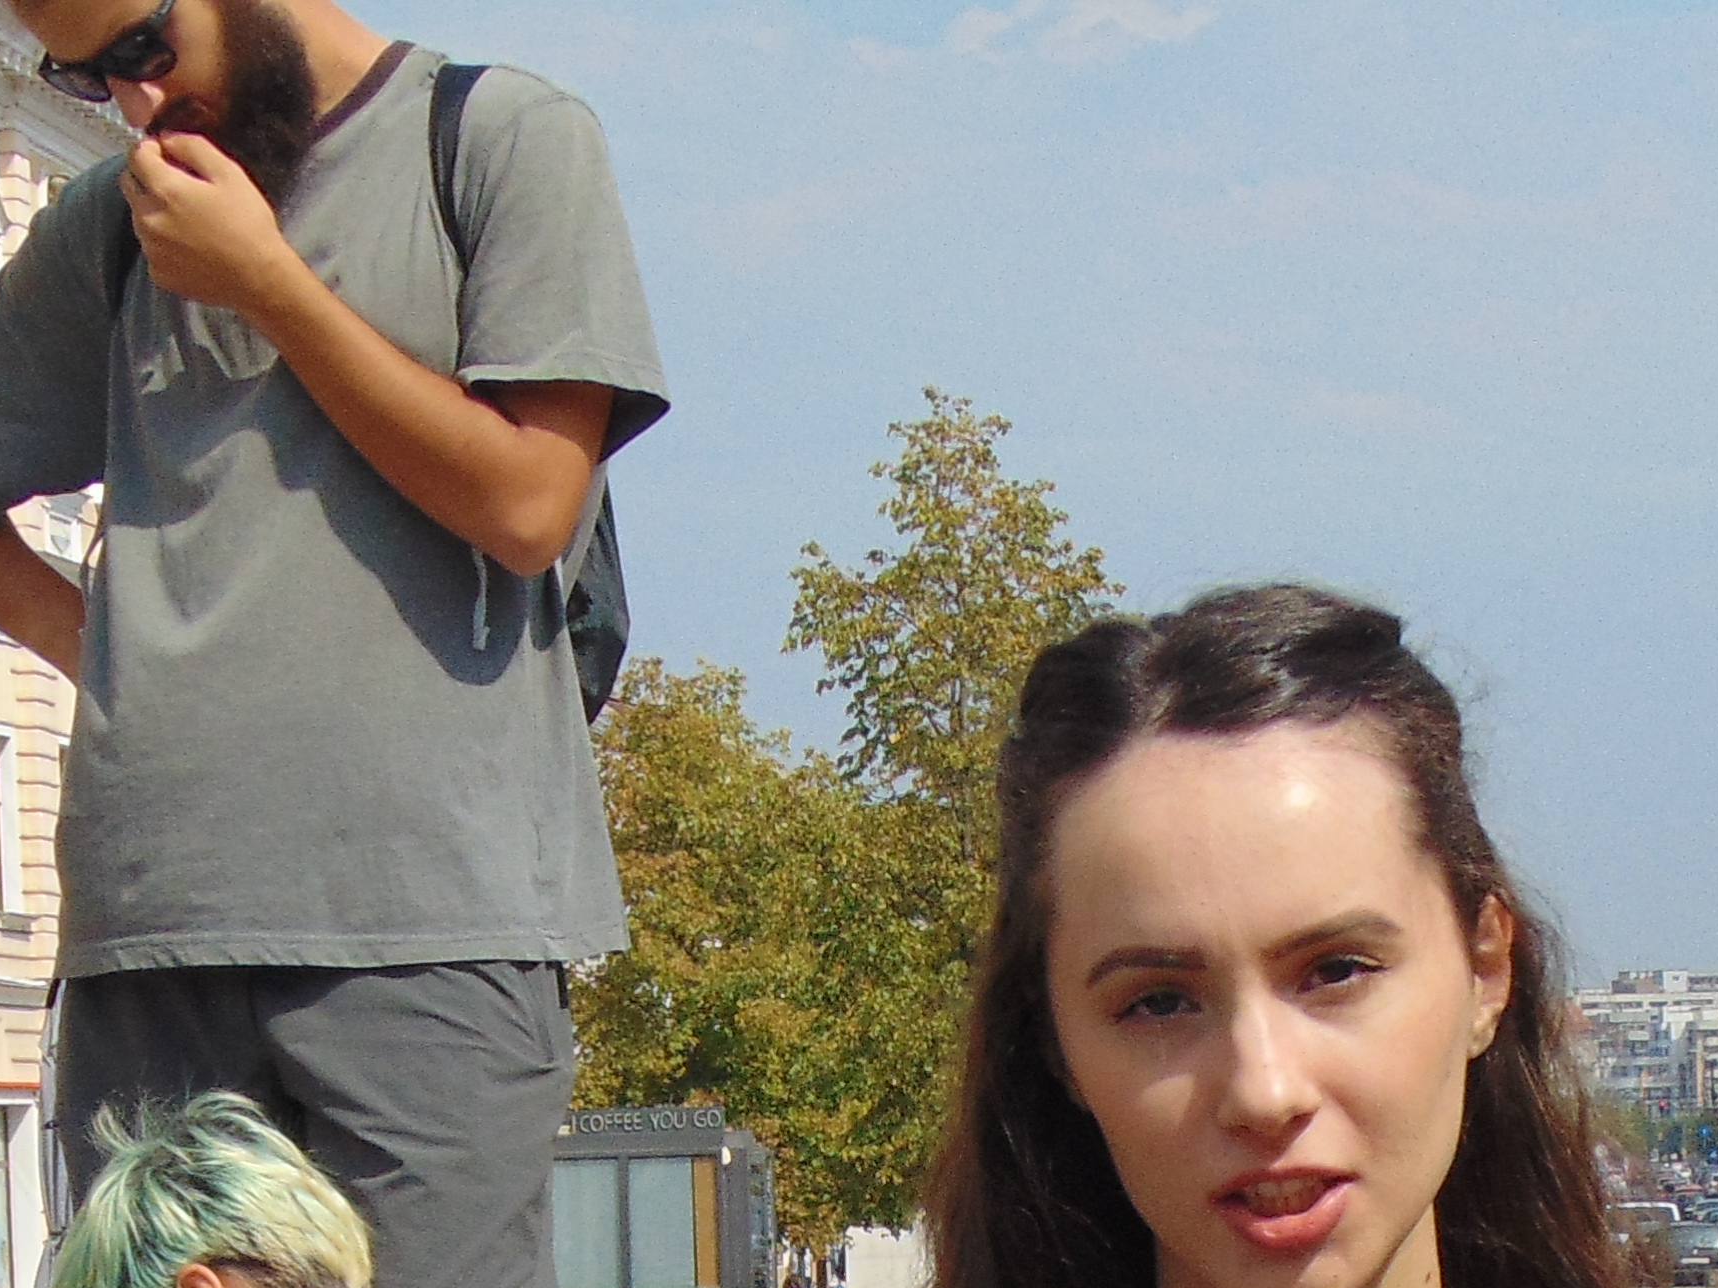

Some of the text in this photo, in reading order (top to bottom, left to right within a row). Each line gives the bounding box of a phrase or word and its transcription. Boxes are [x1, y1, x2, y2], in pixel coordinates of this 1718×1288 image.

[580, 1110, 643, 1135] COFFEE
[649, 1109, 687, 1131] YOU
[692, 1108, 723, 1129] GO
